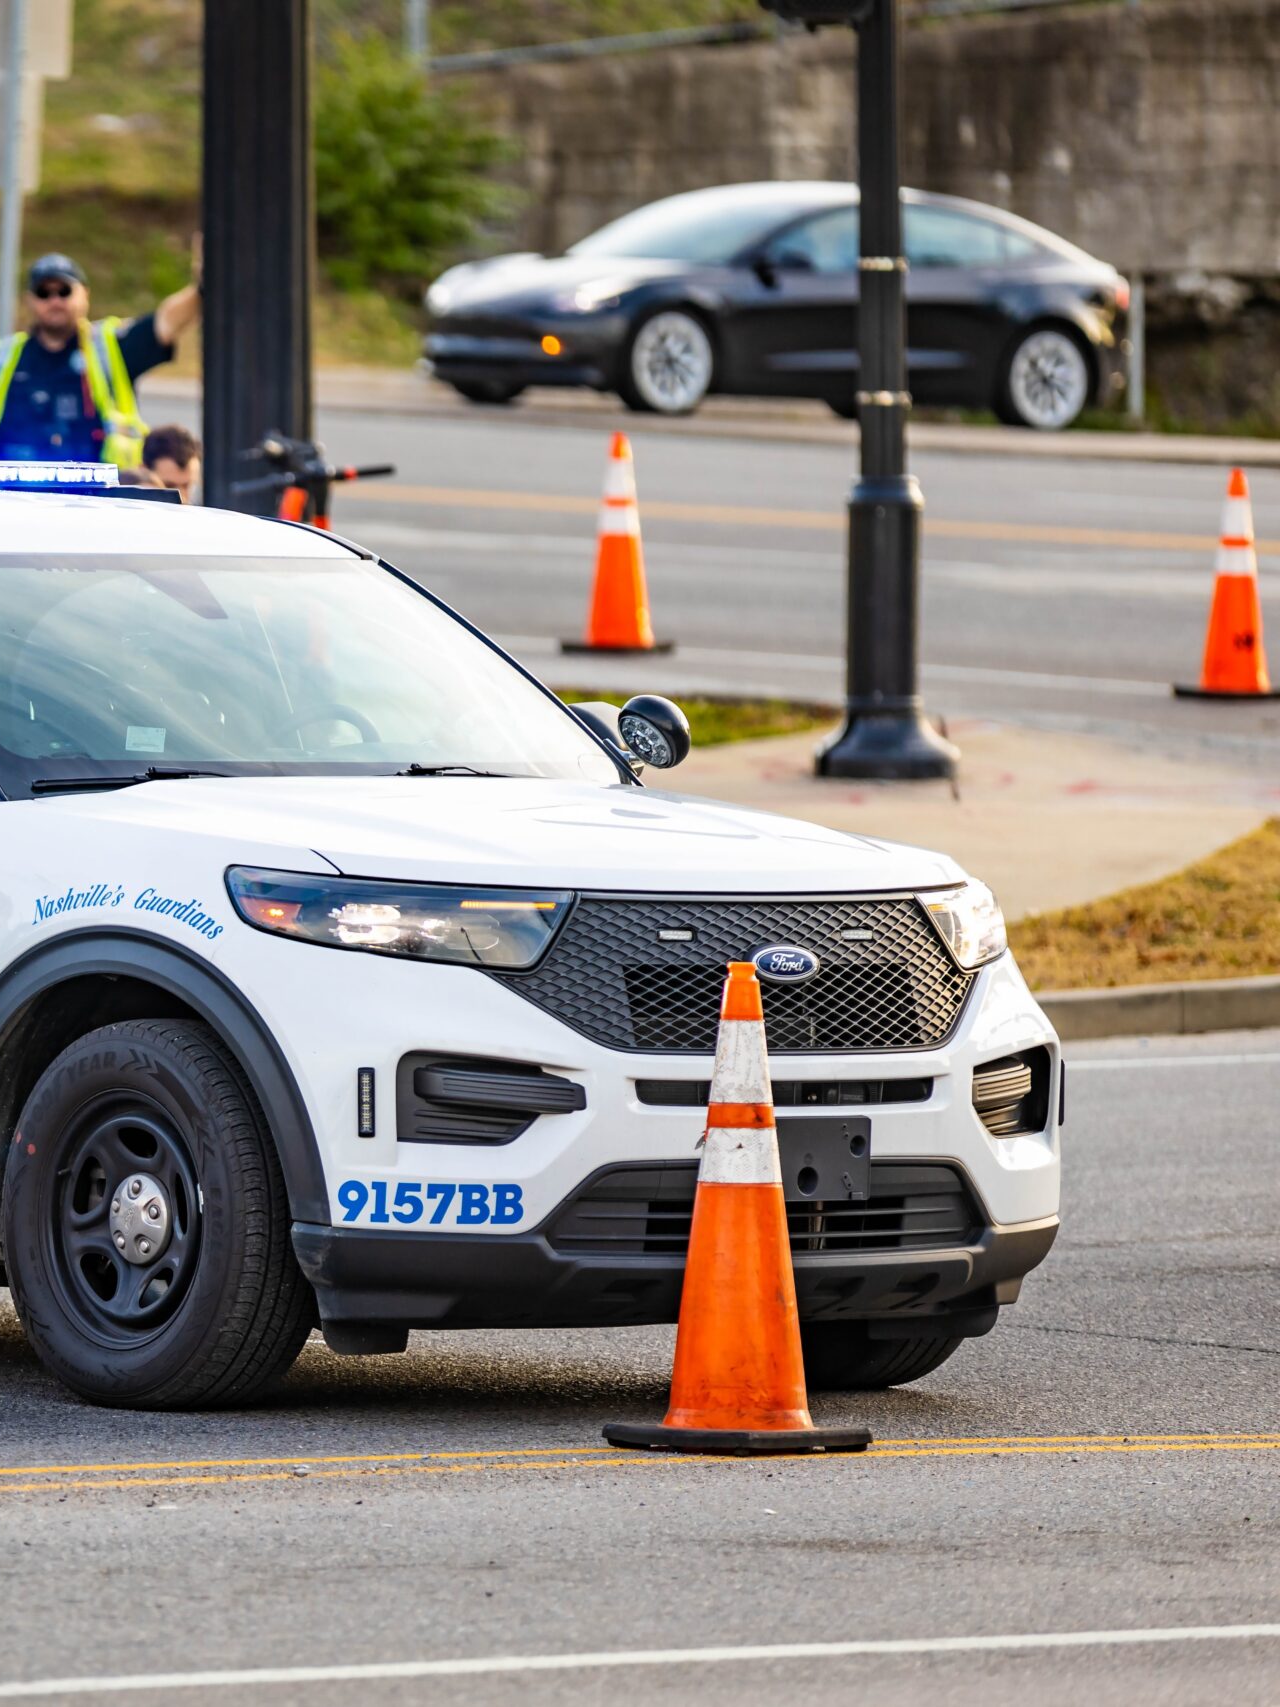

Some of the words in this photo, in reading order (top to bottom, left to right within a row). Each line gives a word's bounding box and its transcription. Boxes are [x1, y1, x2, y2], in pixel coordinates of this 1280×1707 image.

[32, 884, 125, 925] Nashville's
[134, 887, 224, 940] Guardians
[770, 952, 805, 972] Ford
[338, 1179, 524, 1225] 9157BB
